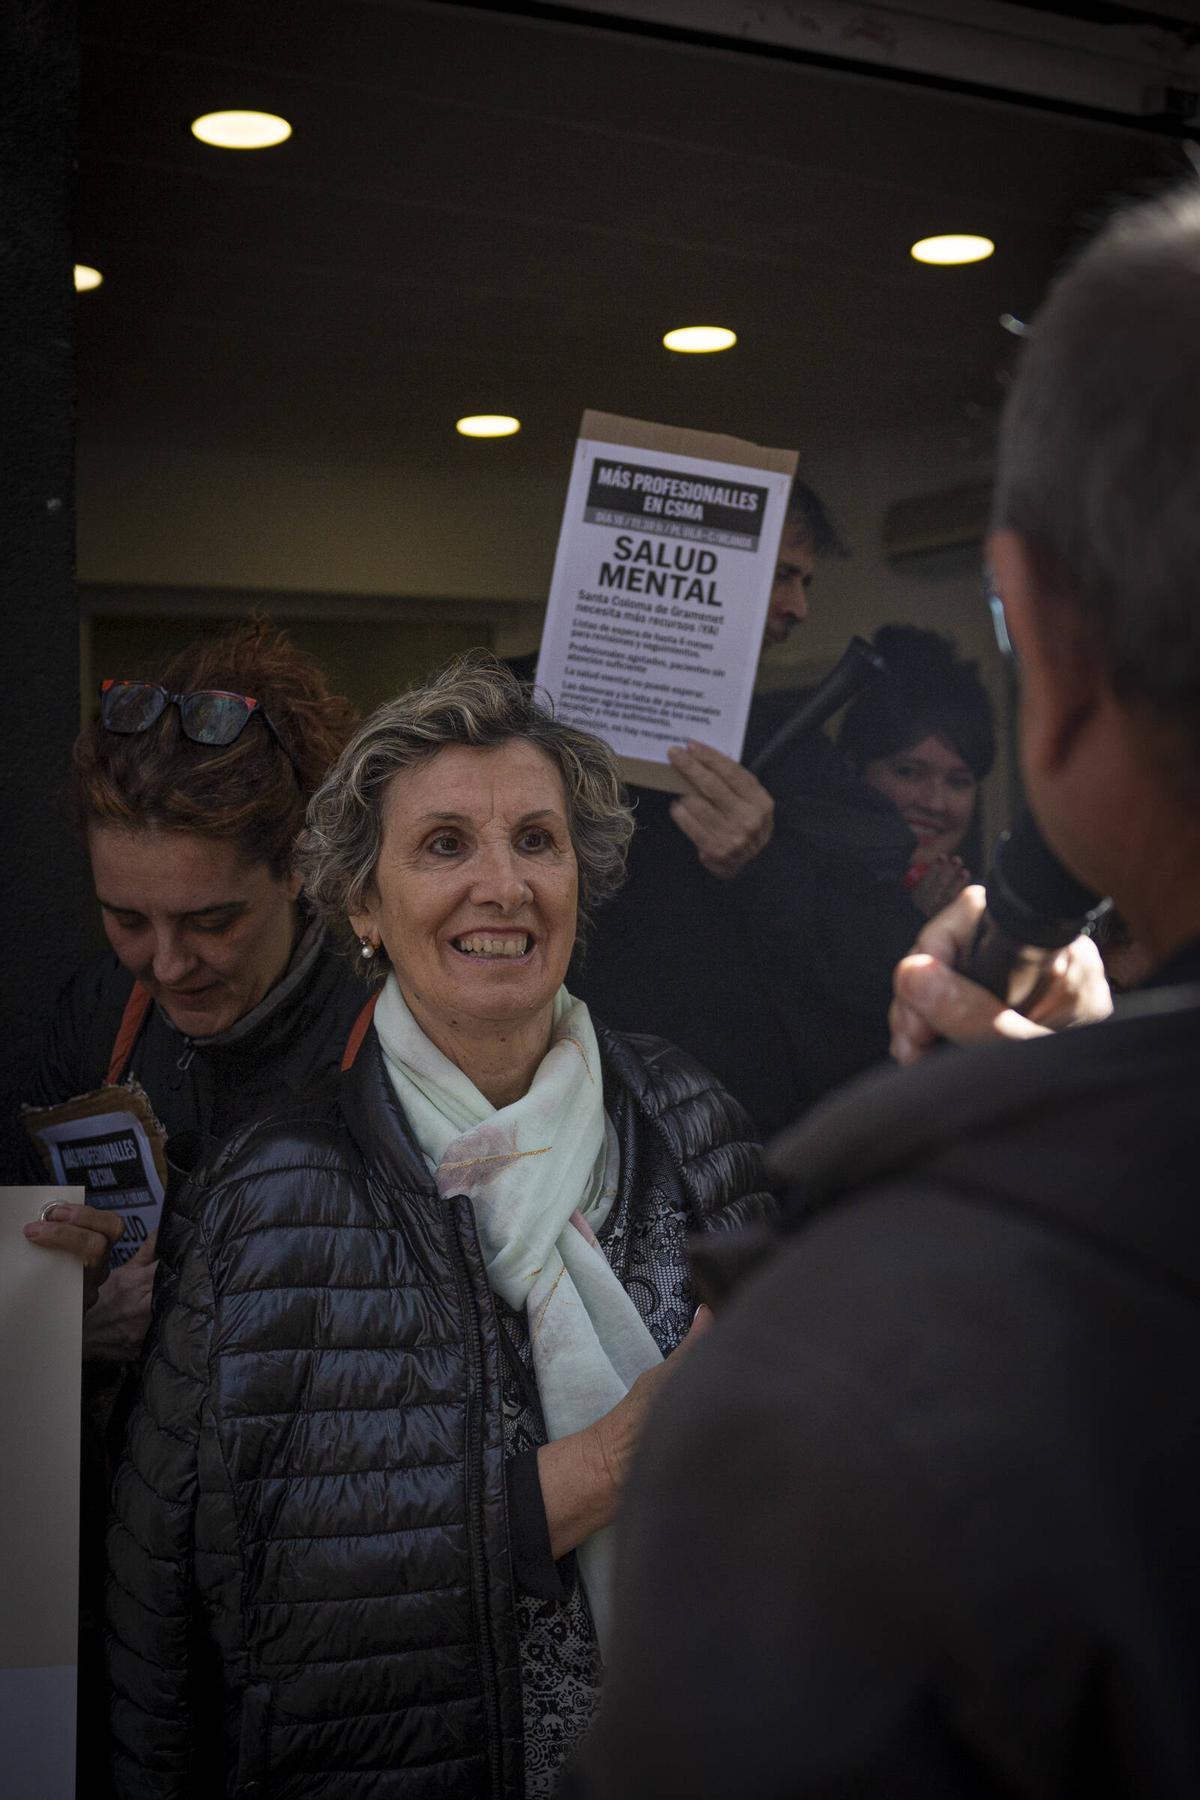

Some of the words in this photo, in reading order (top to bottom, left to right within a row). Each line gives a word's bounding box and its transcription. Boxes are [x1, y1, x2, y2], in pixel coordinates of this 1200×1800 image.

[597, 466, 631, 489] MÁS
[632, 472, 759, 511] PROFESIONALLES
[643, 496, 662, 514] EN
[664, 499, 704, 521] CSMA
[613, 535, 717, 575] SALUD
[598, 562, 722, 607] MENTAL
[574, 602, 621, 619] necesita
[623, 610, 646, 623] más
[648, 615, 695, 631] recursos
[577, 589, 609, 603] Santa
[611, 595, 652, 611] Coloma
[654, 603, 668, 614] de
[669, 606, 724, 624] Gramenet
